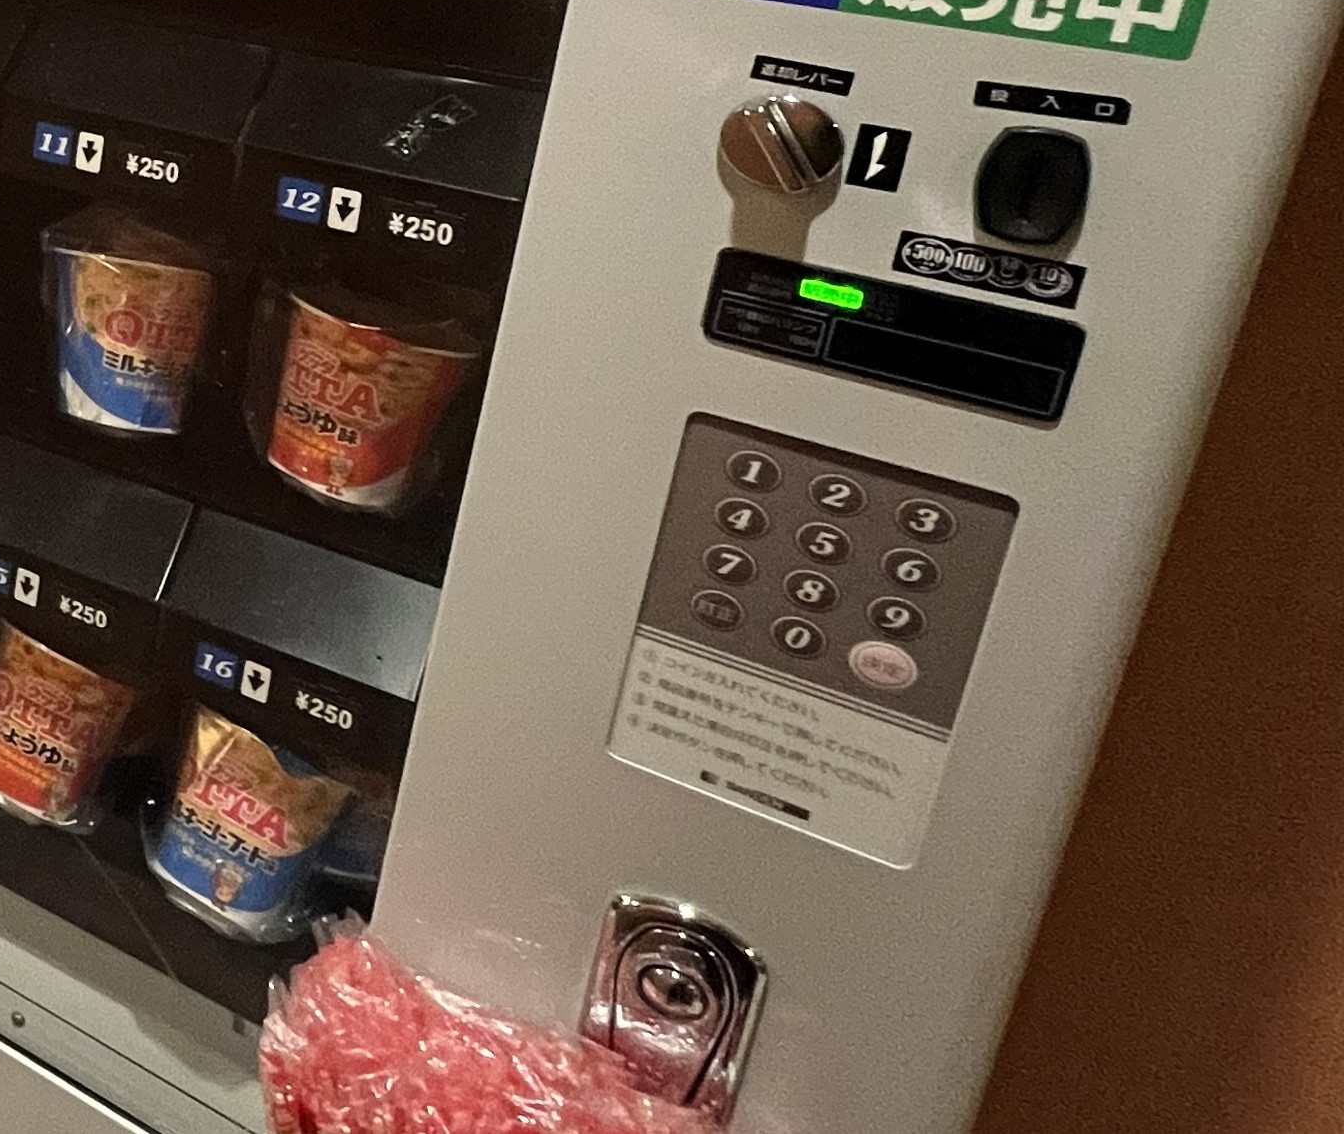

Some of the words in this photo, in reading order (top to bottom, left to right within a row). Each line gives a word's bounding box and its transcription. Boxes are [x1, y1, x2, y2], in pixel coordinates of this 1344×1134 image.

[760, 62, 845, 88] 返却レバー
[38, 131, 69, 157] 11
[126, 152, 179, 184] ¥250
[281, 187, 321, 215] 12
[389, 211, 454, 246] ¥250
[912, 243, 946, 264] 500
[953, 250, 987, 273] 100
[286, 364, 383, 427] TTA
[743, 460, 762, 484] 1
[822, 483, 852, 508] 2
[909, 508, 940, 532] 3
[727, 509, 753, 531] 4
[809, 531, 839, 555] 5
[896, 559, 927, 582] 6
[59, 595, 108, 629] ¥250
[718, 553, 743, 575] 7
[796, 579, 827, 603] 8
[880, 605, 910, 629] 9
[784, 626, 811, 649] 0
[199, 653, 234, 679] 16
[294, 690, 353, 730] ¥250
[192, 775, 289, 850] TTA
